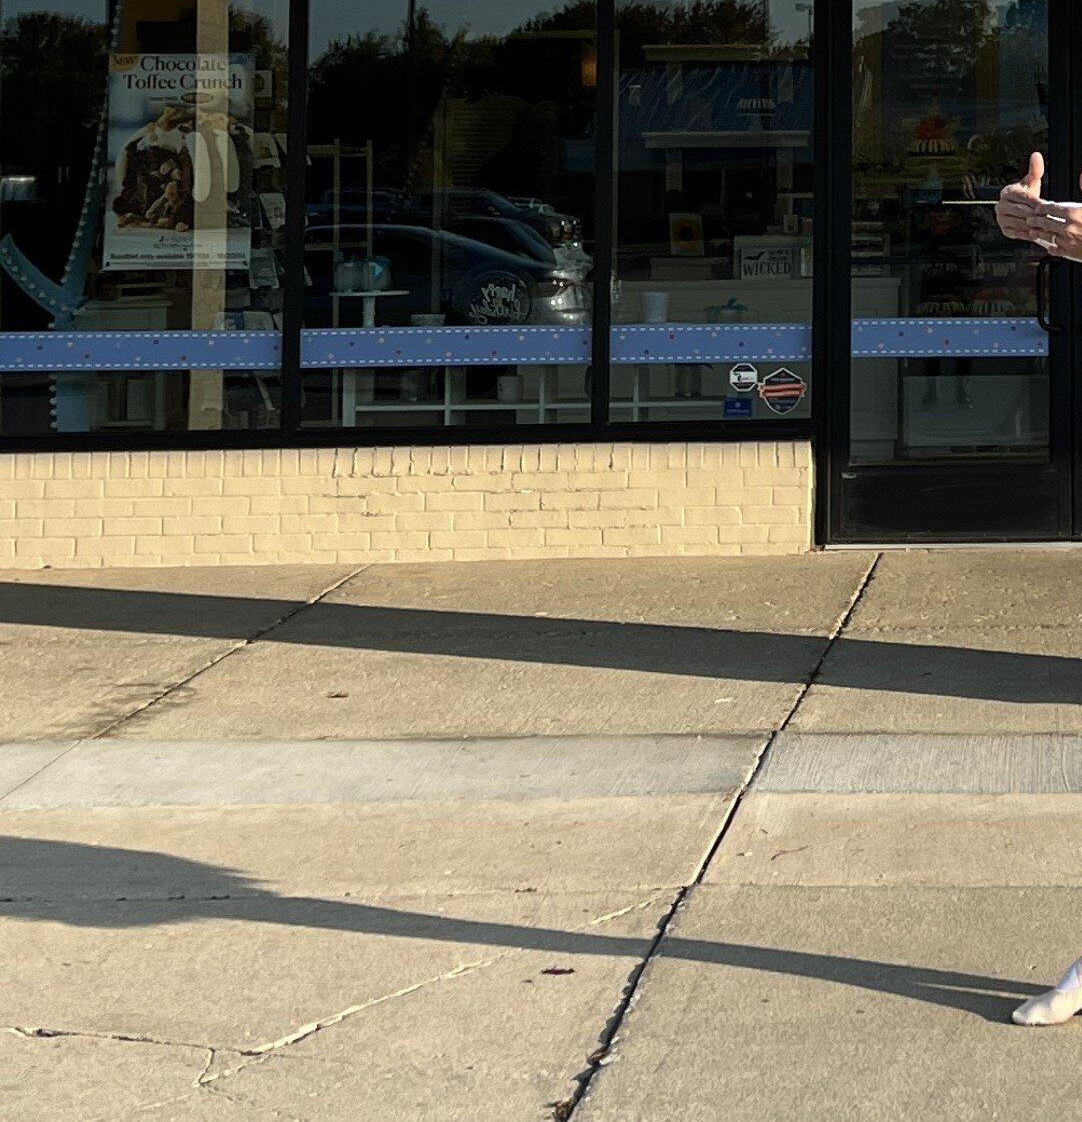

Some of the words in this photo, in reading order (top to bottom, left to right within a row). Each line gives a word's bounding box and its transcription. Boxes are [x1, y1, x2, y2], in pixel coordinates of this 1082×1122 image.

[140, 55, 226, 71] Chocolate
[122, 74, 177, 90] Toffee
[179, 73, 242, 90] Crunch
